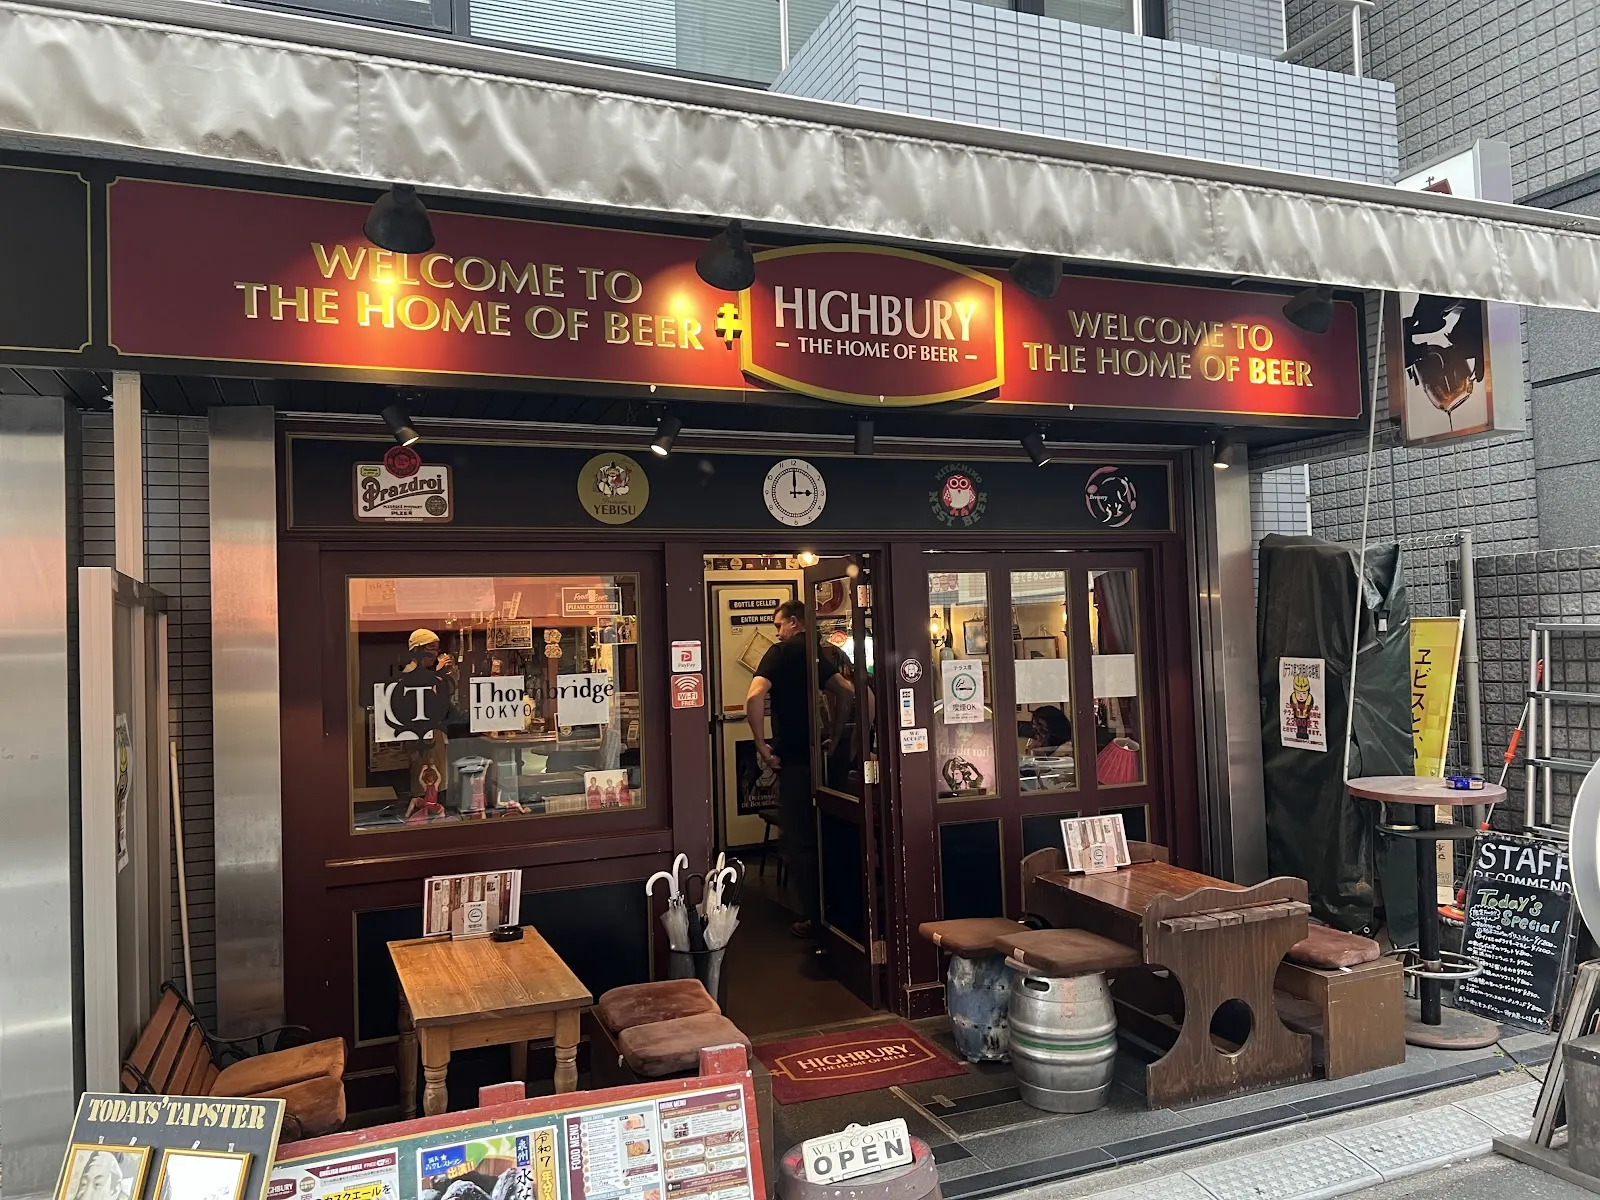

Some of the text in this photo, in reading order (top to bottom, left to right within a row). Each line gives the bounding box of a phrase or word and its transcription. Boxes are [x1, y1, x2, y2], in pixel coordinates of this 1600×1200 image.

[311, 242, 642, 303] WELCOME TO
[234, 281, 704, 351] THE HOME OF BEER
[775, 286, 976, 341] HIGHBURY
[1068, 309, 1274, 351] WELCOME TO
[798, 337, 959, 362] THE HOME OF BEER
[1023, 342, 1313, 387] THE HOME OF BEER
[361, 474, 445, 512] Prazdroj
[594, 504, 636, 516] YEBISU
[962, 492, 988, 527] BEER
[755, 599, 777, 607] CELLER
[470, 677, 614, 704] Thornbridge
[679, 692, 697, 700] Wi-Fi
[474, 703, 532, 720] TOKYO
[1478, 842, 1569, 880] STAFF
[1477, 888, 1543, 917] Today's
[1500, 909, 1560, 934] Special
[797, 1043, 909, 1070] HIGHBURY
[165, 1102, 267, 1130] TAPSTER
[673, 1098, 687, 1107] MENU
[568, 1123, 581, 1171] FOOD MENU
[812, 1127, 902, 1156] WELCOME
[813, 1138, 905, 1176] OPEN
